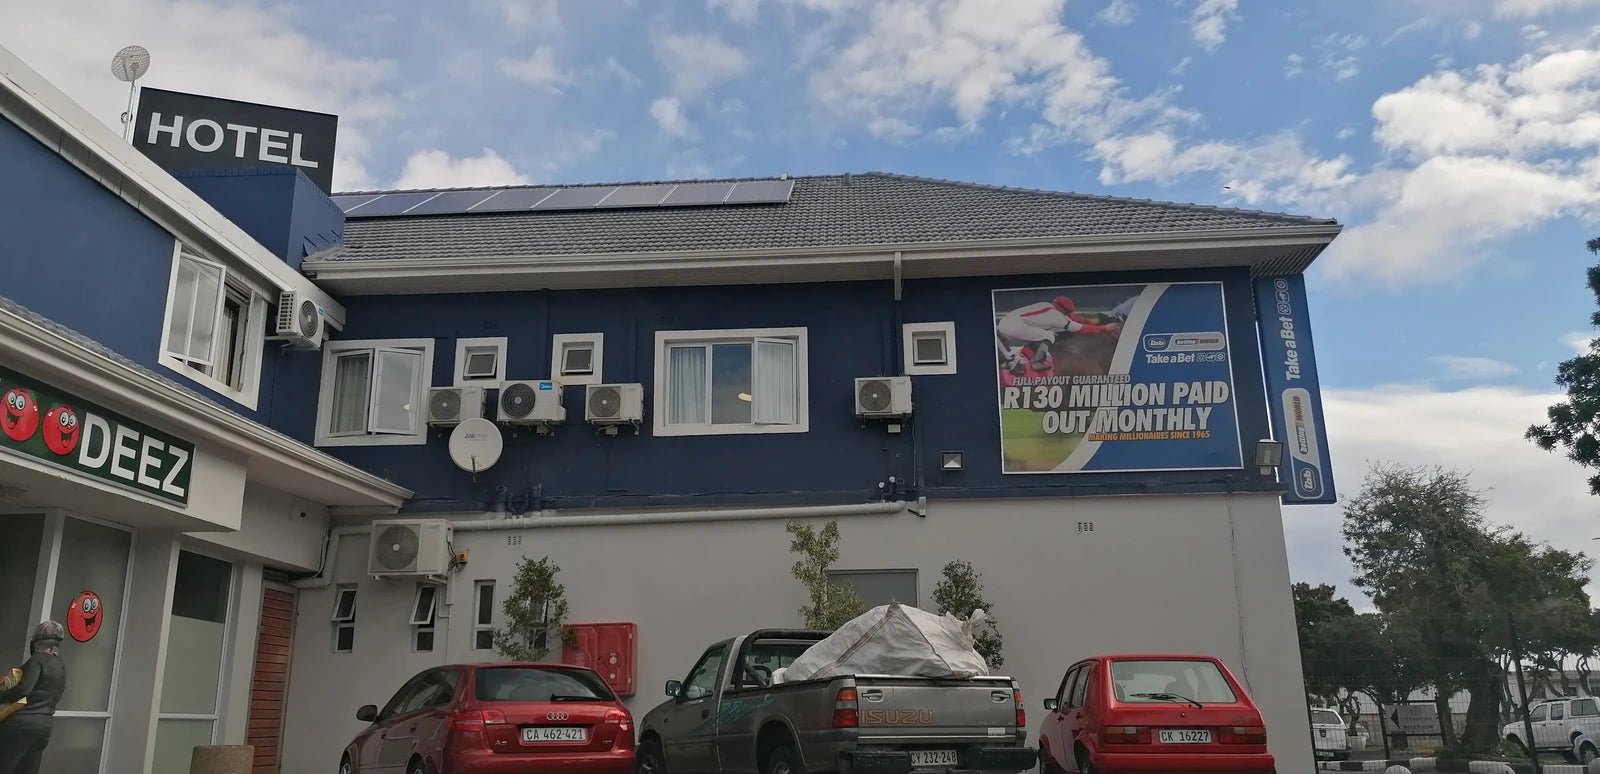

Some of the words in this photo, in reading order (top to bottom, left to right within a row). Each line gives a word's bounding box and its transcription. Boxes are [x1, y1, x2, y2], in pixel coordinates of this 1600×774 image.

[147, 112, 319, 168] HOTEL
[1279, 316, 1295, 340] Bet
[1285, 340, 1297, 349] a
[1146, 353, 1169, 364] Take
[1170, 355, 1177, 363] a
[1177, 353, 1195, 363] Bet
[1284, 349, 1300, 381] Take
[1012, 377, 1033, 387] FULL
[1035, 376, 1071, 386] PAYOUT
[1072, 374, 1131, 384] GUARANTEED
[1003, 385, 1063, 409] R130
[1068, 382, 1166, 408] MILLION
[1172, 381, 1229, 405] PAID
[1293, 396, 1303, 421] WORLD
[1042, 410, 1090, 434] OUT
[1096, 406, 1213, 433] MONTHLY
[1088, 432, 1118, 441] MAKING
[1120, 431, 1169, 440] MILLIONAIRES
[1170, 431, 1190, 439] SINCE
[1192, 430, 1210, 439] 1965
[1298, 425, 1308, 455] betting
[78, 412, 190, 497] DEEZ
[1303, 469, 1313, 490] tab
[860, 709, 934, 725] ISUZU
[526, 729, 539, 740] CA
[543, 728, 583, 740] 462-421
[1161, 731, 1174, 742] CK
[1178, 731, 1209, 742] 16227
[911, 752, 921, 764] CY
[923, 751, 957, 764] 232-248
